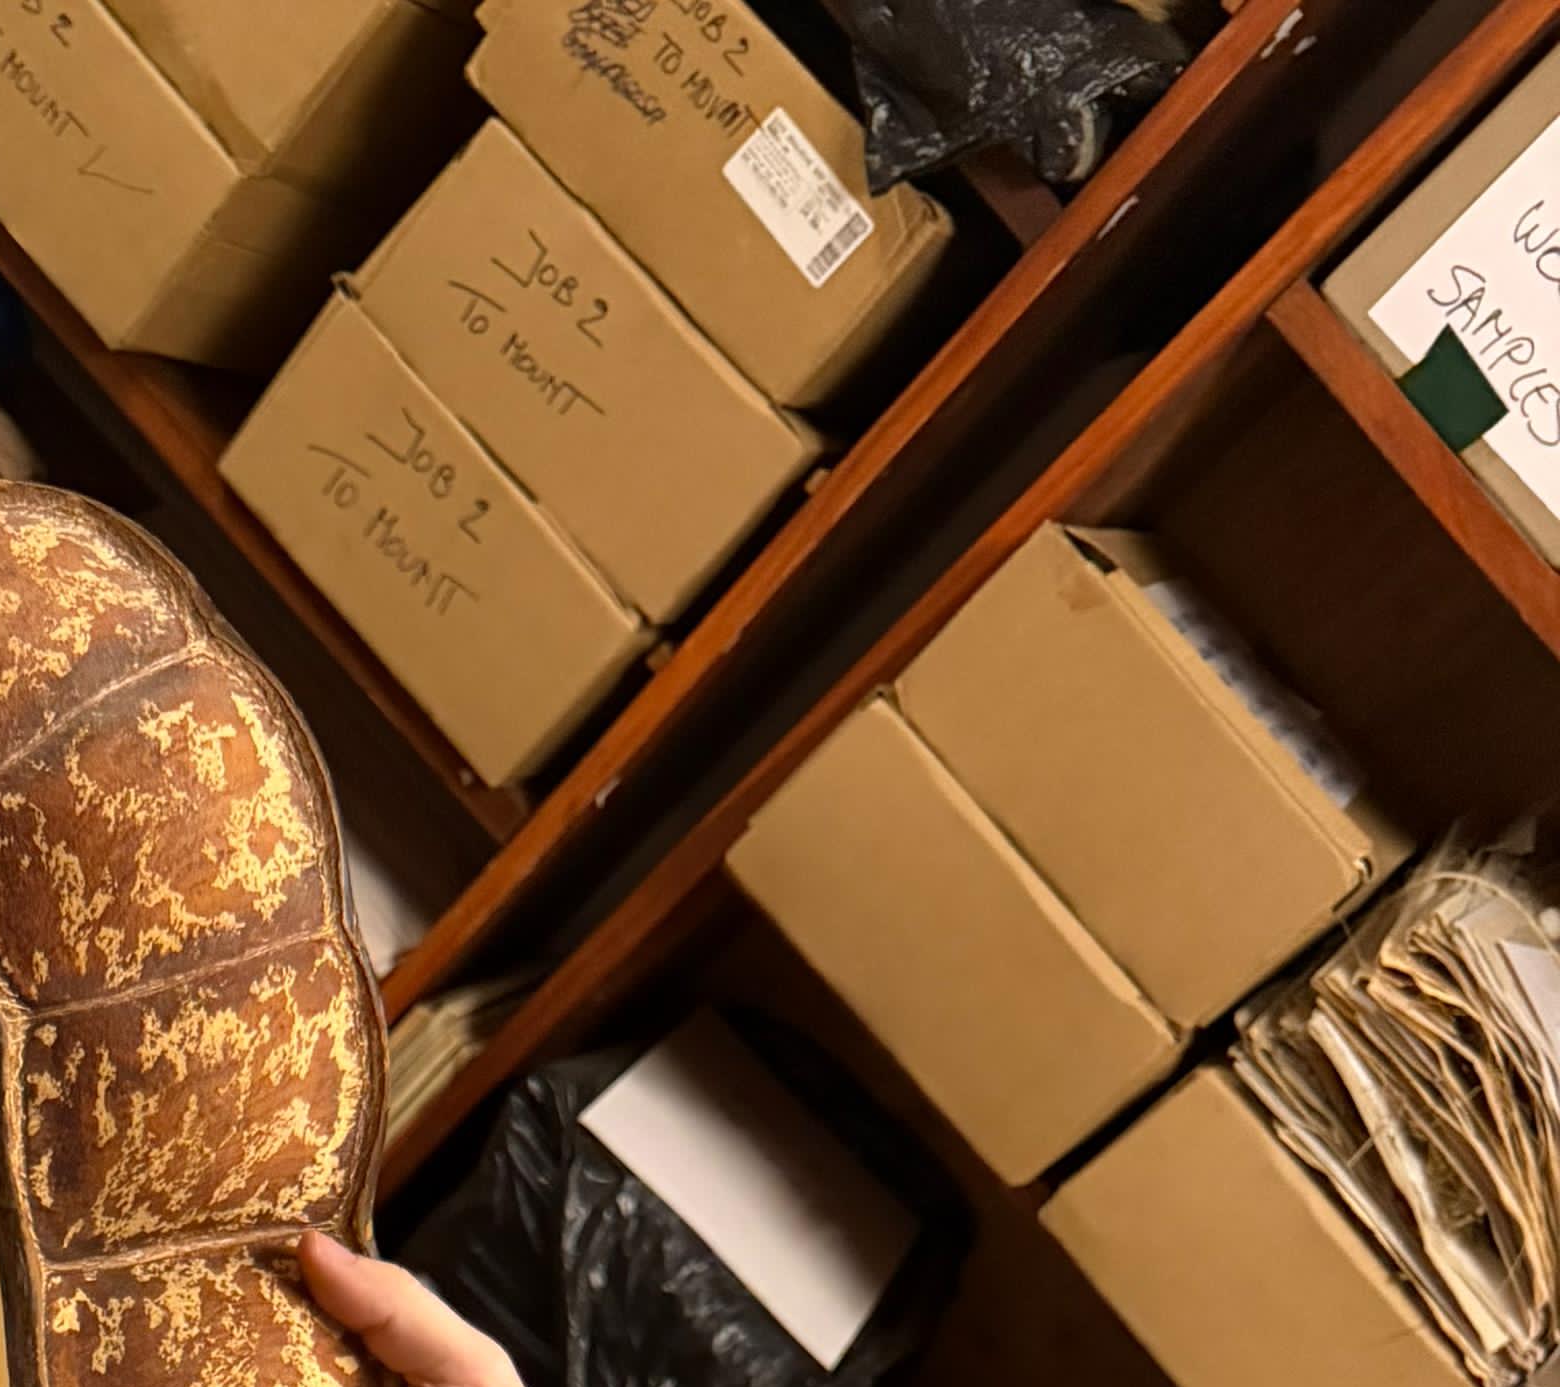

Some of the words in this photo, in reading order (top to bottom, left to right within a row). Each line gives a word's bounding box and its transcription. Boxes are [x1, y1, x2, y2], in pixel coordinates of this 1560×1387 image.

[653, 31, 684, 75] TO
[722, 36, 750, 77] 2
[490, 228, 579, 307] JOB
[575, 297, 609, 348] 2
[1513, 199, 1560, 296] WO
[364, 406, 456, 499] JOB
[456, 498, 489, 545] 2
